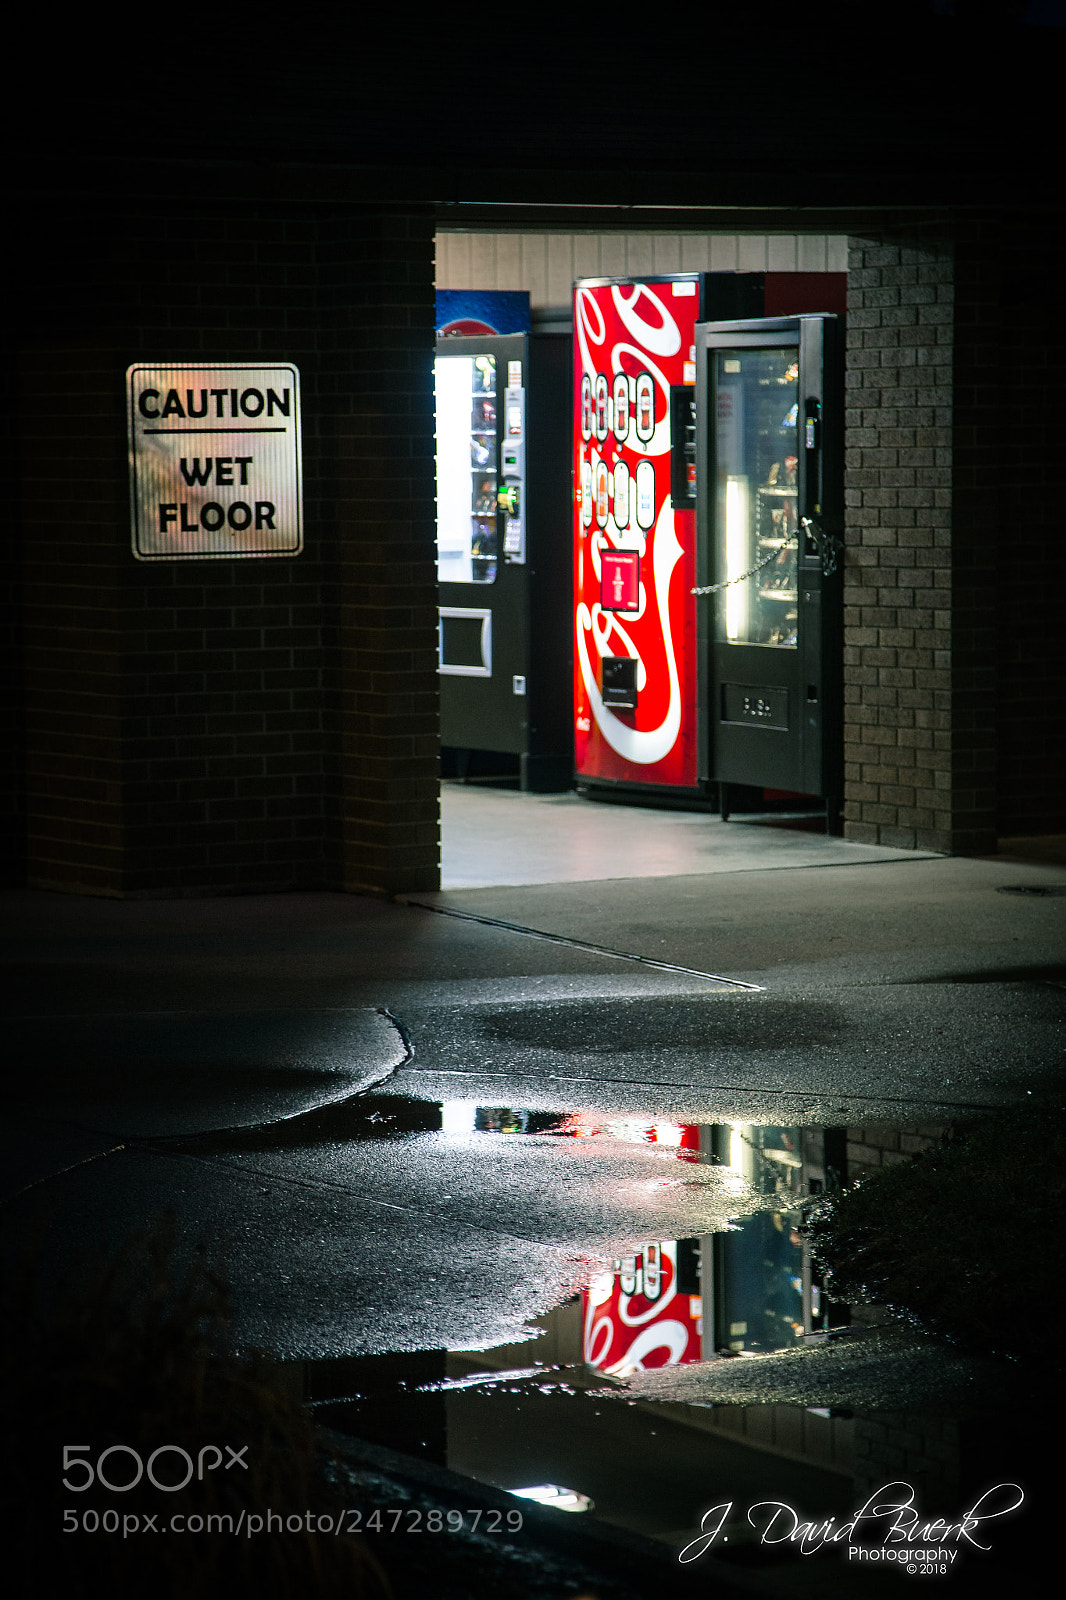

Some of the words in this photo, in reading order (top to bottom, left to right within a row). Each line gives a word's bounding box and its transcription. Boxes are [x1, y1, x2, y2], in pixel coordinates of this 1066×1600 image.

[138, 387, 290, 419] CAUTION
[180, 456, 253, 487] WET
[159, 501, 276, 533] FLOOR
